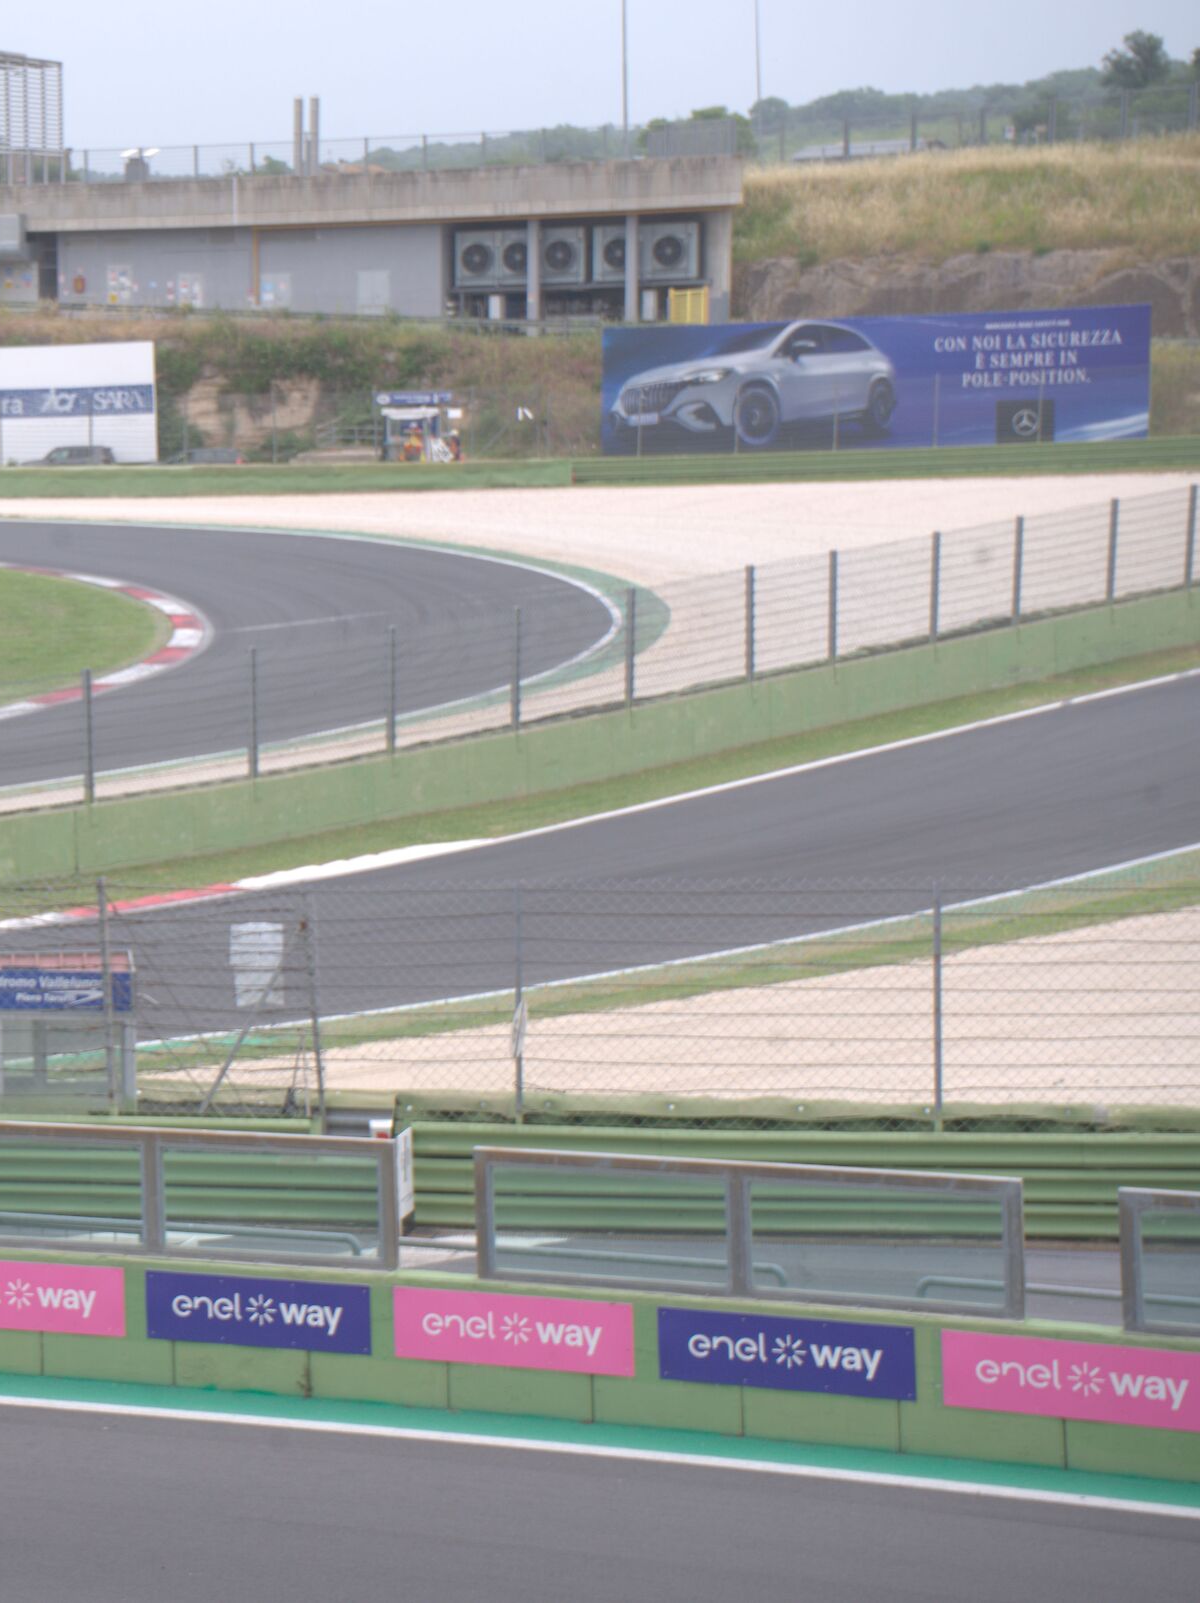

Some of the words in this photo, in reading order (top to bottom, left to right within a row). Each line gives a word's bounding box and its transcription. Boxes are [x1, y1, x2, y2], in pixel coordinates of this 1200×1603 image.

[934, 336, 967, 352] CON
[972, 334, 1002, 350] NOI
[1006, 333, 1027, 349] LA
[1031, 329, 1123, 347] SICUREZZA
[990, 352, 1056, 368] SEMPRE
[1060, 350, 1079, 366] IN
[36, 1286, 97, 1319] way
[172, 1293, 243, 1321] enel
[280, 1302, 344, 1336] way
[422, 1311, 497, 1340] enel
[535, 1322, 603, 1356] way
[688, 1332, 768, 1363] enel
[810, 1343, 883, 1381] way
[975, 1358, 1063, 1391] enel
[1108, 1371, 1190, 1411] way
